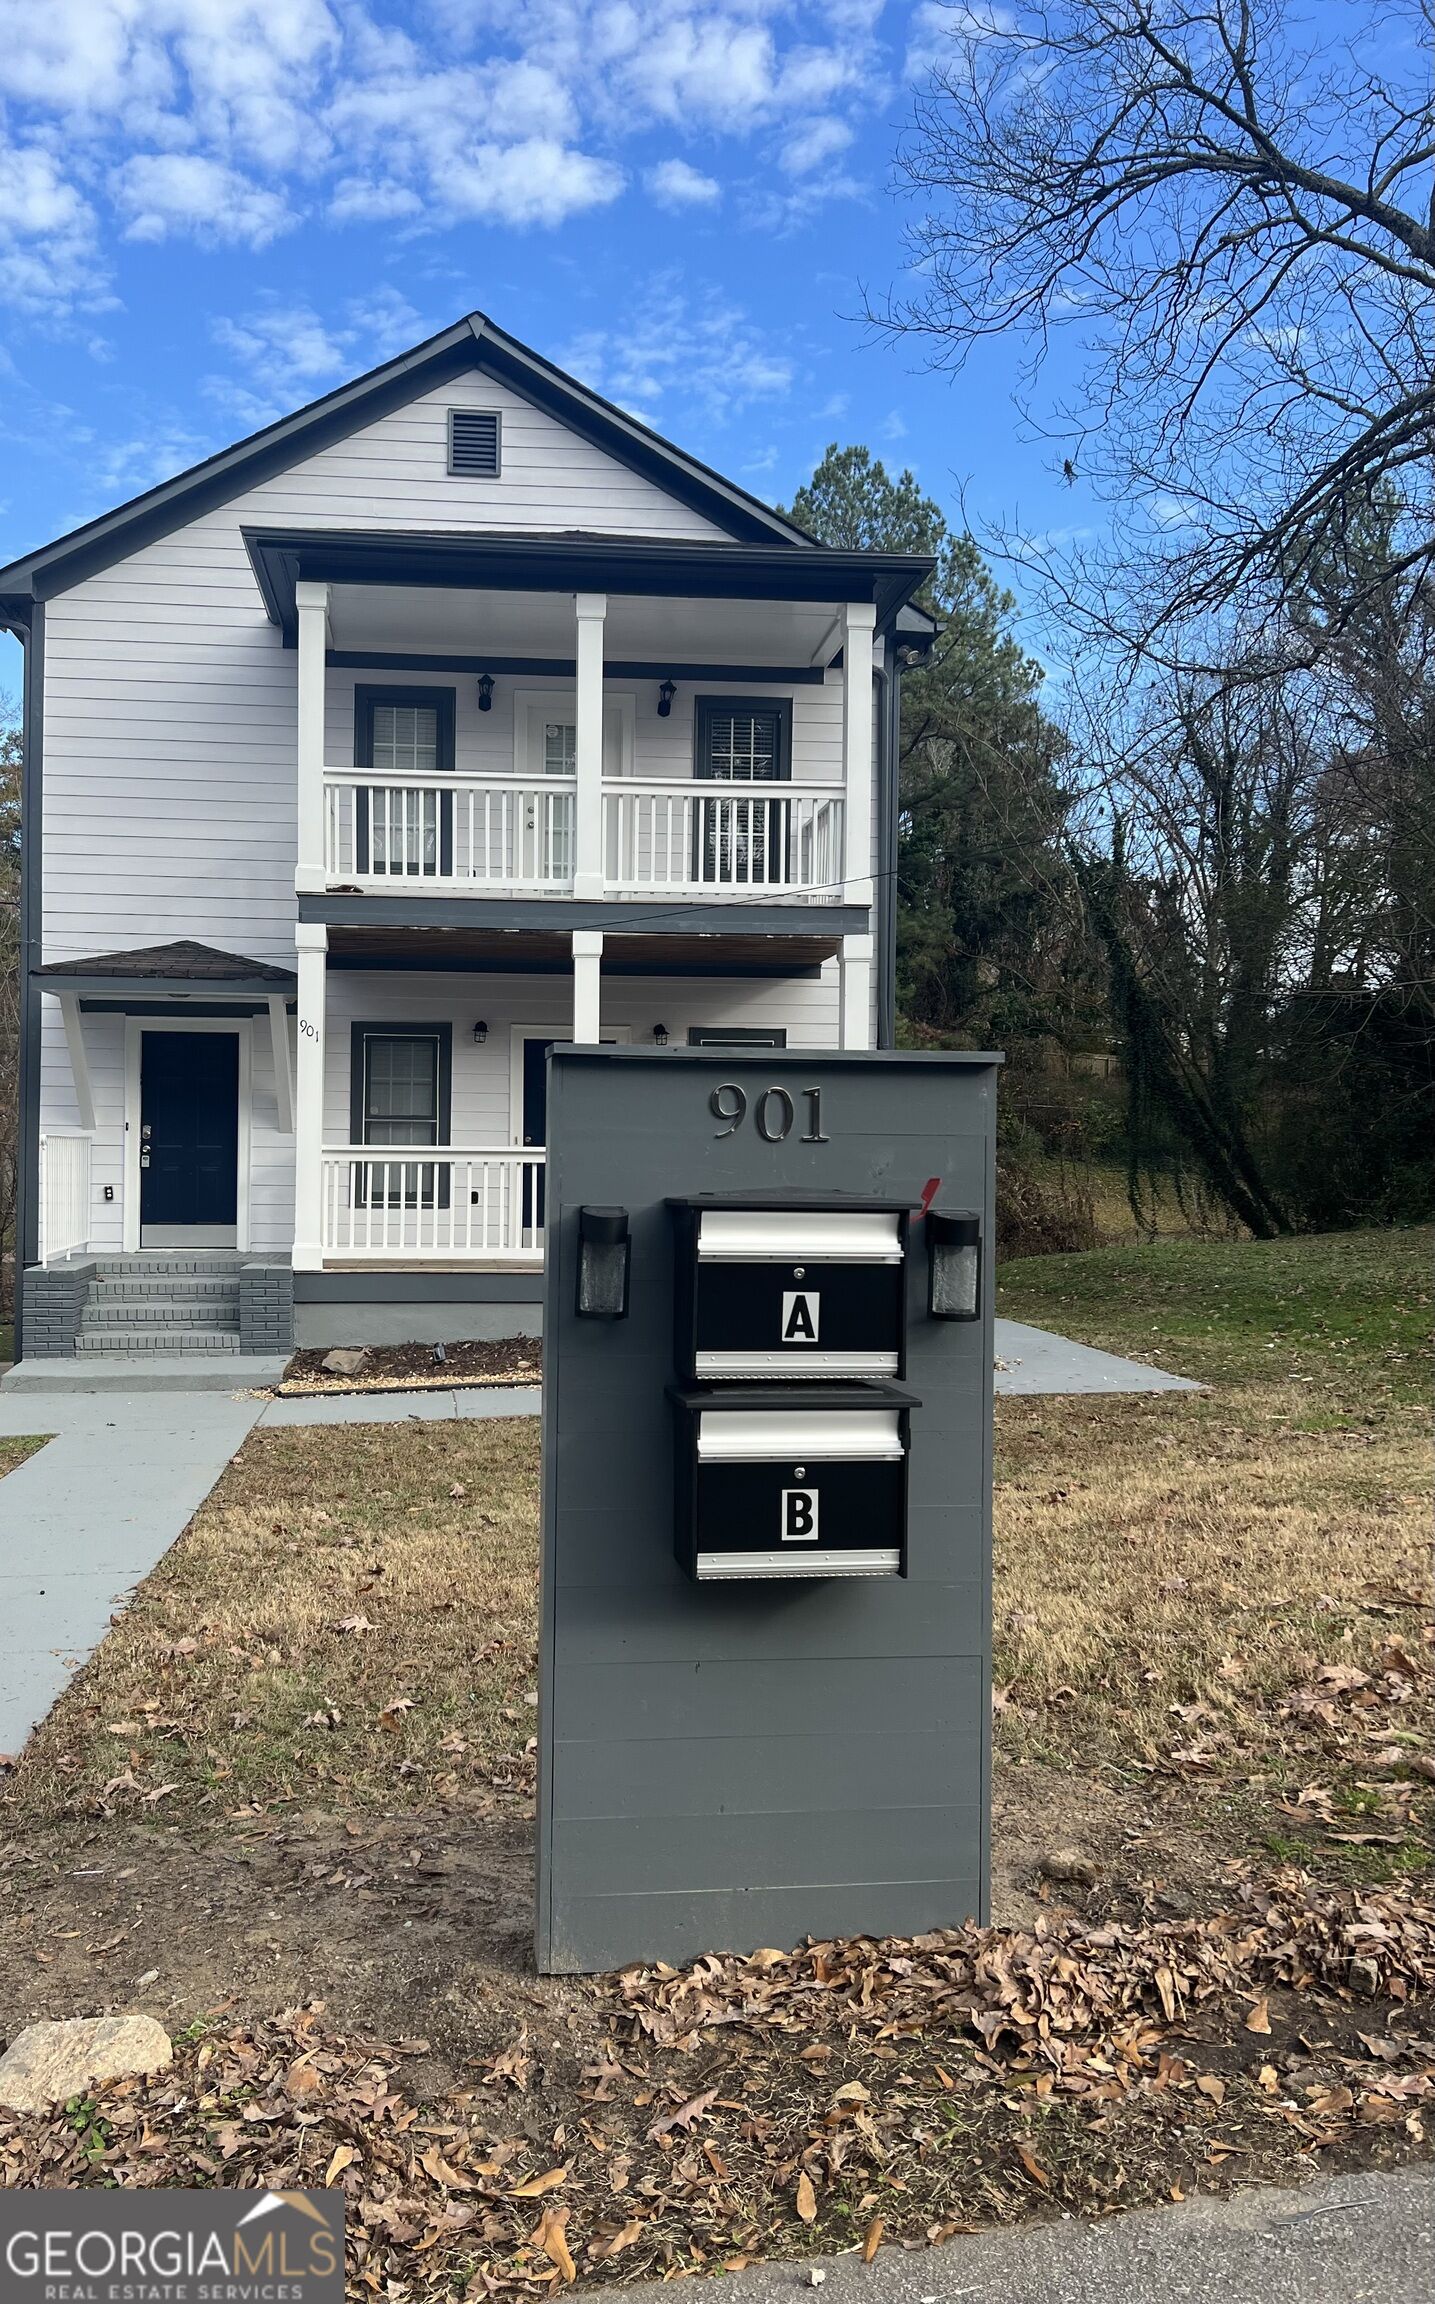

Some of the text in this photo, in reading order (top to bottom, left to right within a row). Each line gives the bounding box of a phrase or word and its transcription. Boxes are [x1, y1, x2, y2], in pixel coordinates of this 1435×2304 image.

[299, 1019, 319, 1043] 901
[709, 1083, 831, 1142] 901
[784, 1295, 816, 1339] A
[786, 1492, 814, 1536] B
